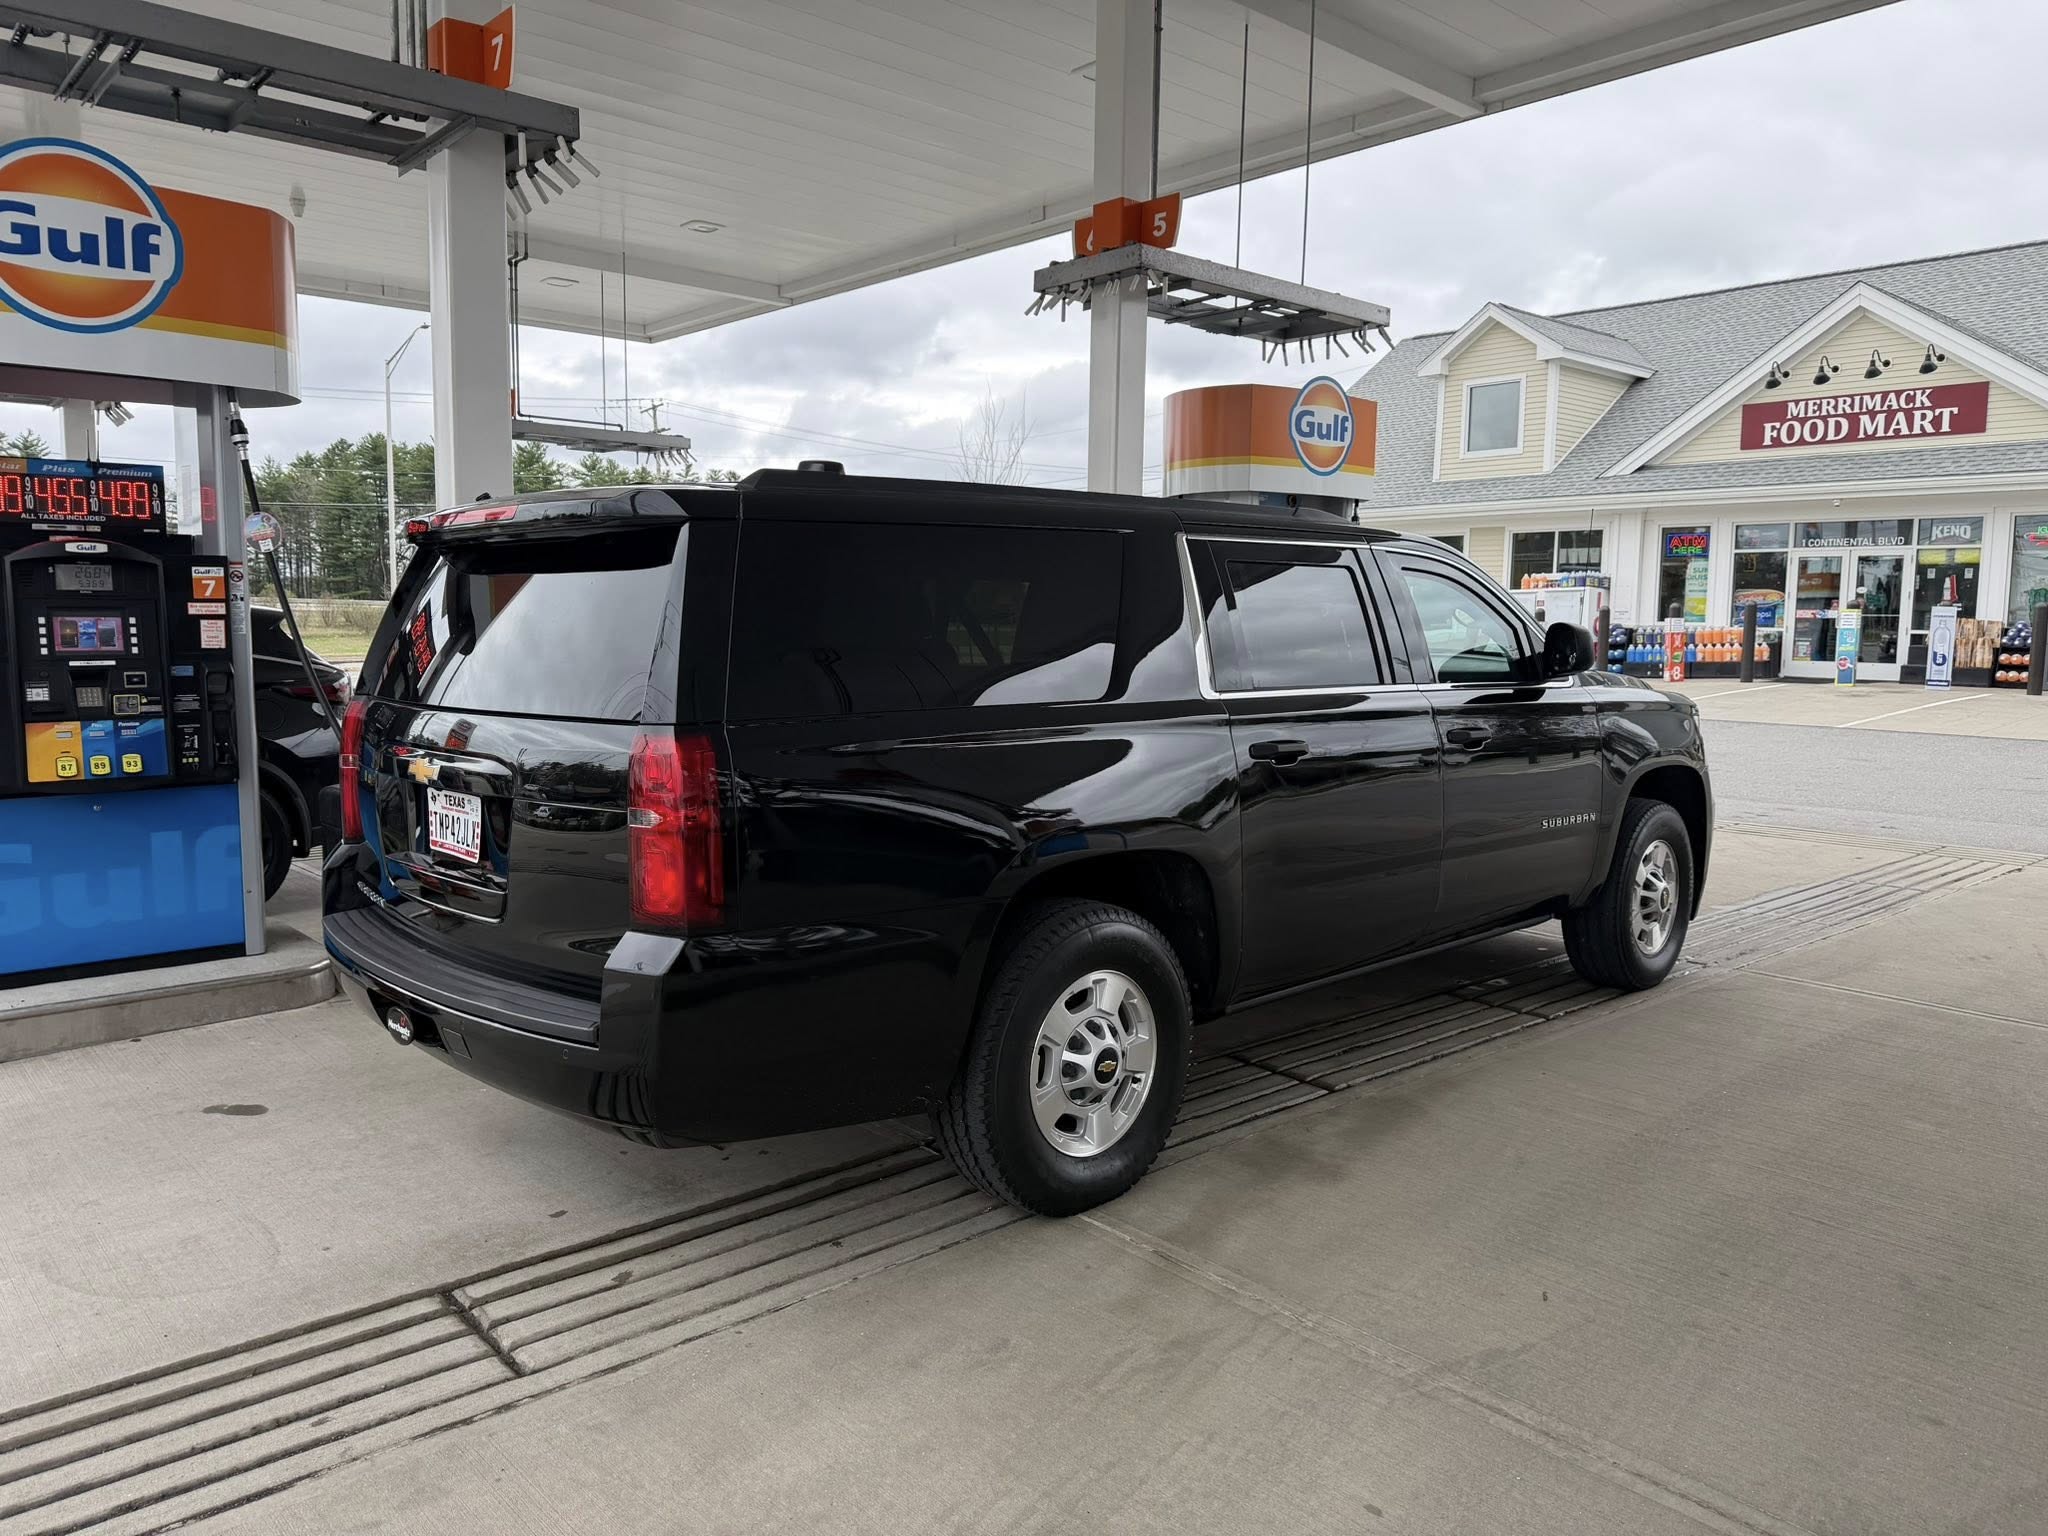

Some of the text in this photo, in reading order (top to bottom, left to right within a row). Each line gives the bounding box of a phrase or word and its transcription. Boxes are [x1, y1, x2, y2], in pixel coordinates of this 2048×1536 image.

[491, 32, 504, 72] 7
[1152, 211, 1167, 238] 5
[0, 200, 162, 274] Gulf
[1786, 388, 1933, 419] MERRIMACK
[1295, 409, 1349, 443] Gulf
[1762, 406, 1959, 446] FOOD MART
[42, 463, 76, 473] Plus
[97, 467, 153, 477] Premium
[66, 514, 107, 522] INCLUDED
[1931, 524, 1971, 541] KENO
[76, 544, 97, 552] Gulf
[1670, 535, 1707, 548] ATM
[1802, 536, 1905, 547] 1 CONTINENTAL BLVD
[1672, 546, 1703, 554] HERE
[201, 580, 216, 597] 7
[60, 763, 73, 772] 87
[93, 762, 106, 770] 89
[125, 760, 138, 768] 93
[444, 793, 466, 810] TEXAS
[1542, 812, 1596, 829] SUBURBAN
